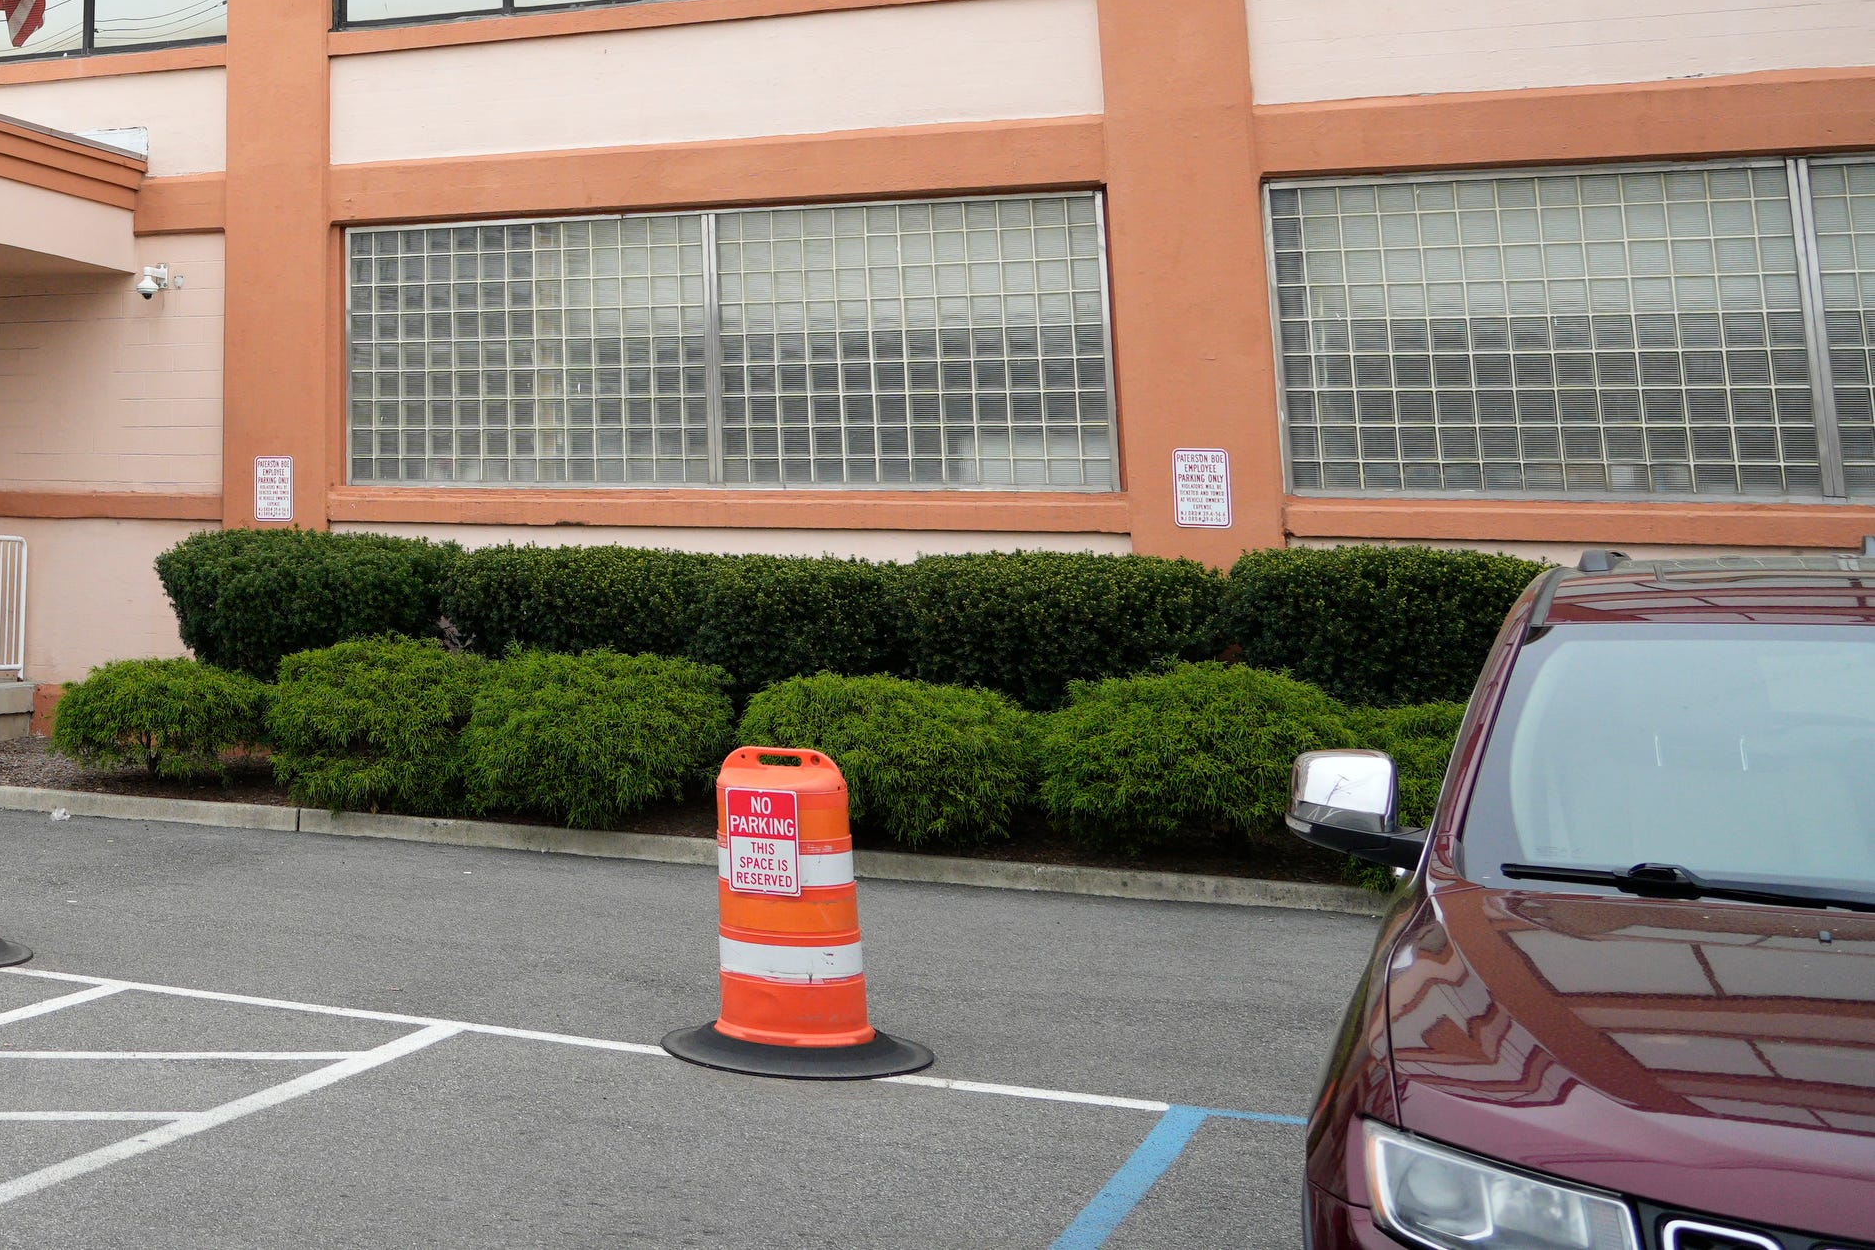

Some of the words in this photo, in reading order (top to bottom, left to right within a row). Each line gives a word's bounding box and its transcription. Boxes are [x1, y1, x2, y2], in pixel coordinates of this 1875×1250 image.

[1176, 453, 1208, 463] PATERSON
[1211, 454, 1224, 464] BOE
[1184, 463, 1217, 473] EMPLOYEE
[1178, 473, 1205, 483] PARKING
[1208, 474, 1224, 483] ONLY
[750, 796, 772, 815] NO
[729, 815, 795, 837] PARKING
[750, 841, 775, 855] THIS
[739, 856, 774, 871] SPACE
[778, 859, 788, 872] IS
[736, 871, 793, 888] RESERVED
